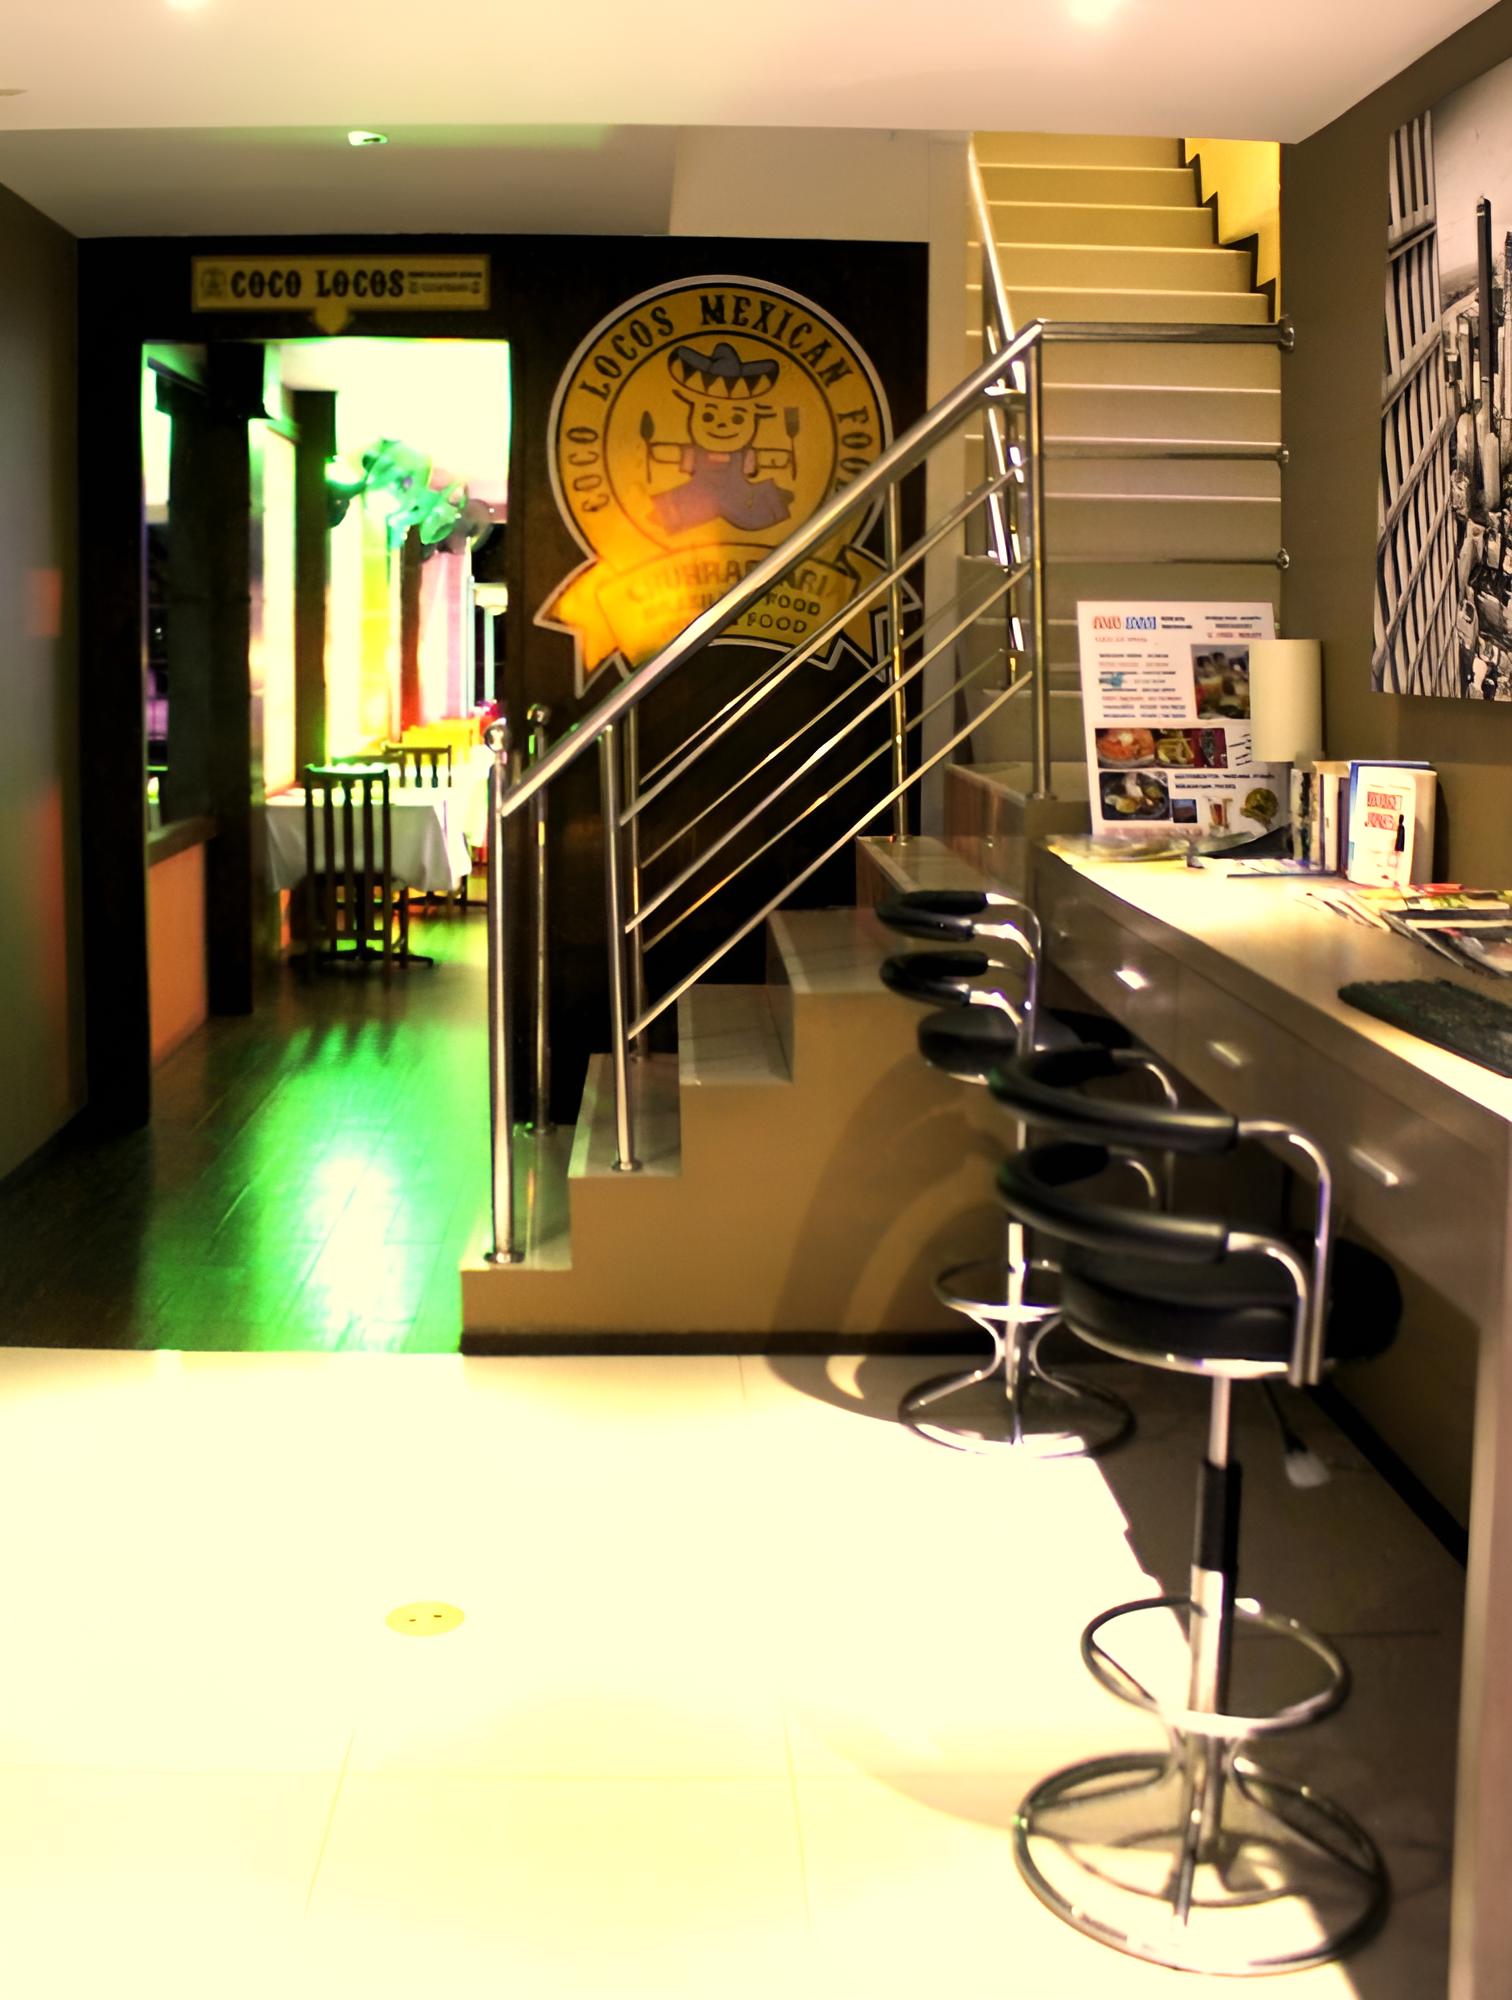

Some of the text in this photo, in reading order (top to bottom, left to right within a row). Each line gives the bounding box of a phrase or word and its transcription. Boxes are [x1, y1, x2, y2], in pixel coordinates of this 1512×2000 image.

[231, 269, 302, 298] COCO
[315, 269, 405, 298] LOCOS
[578, 305, 674, 402] LOCOS
[699, 294, 854, 388] MEXICAN
[566, 426, 610, 512] COCO
[746, 612, 807, 634] FOOD
